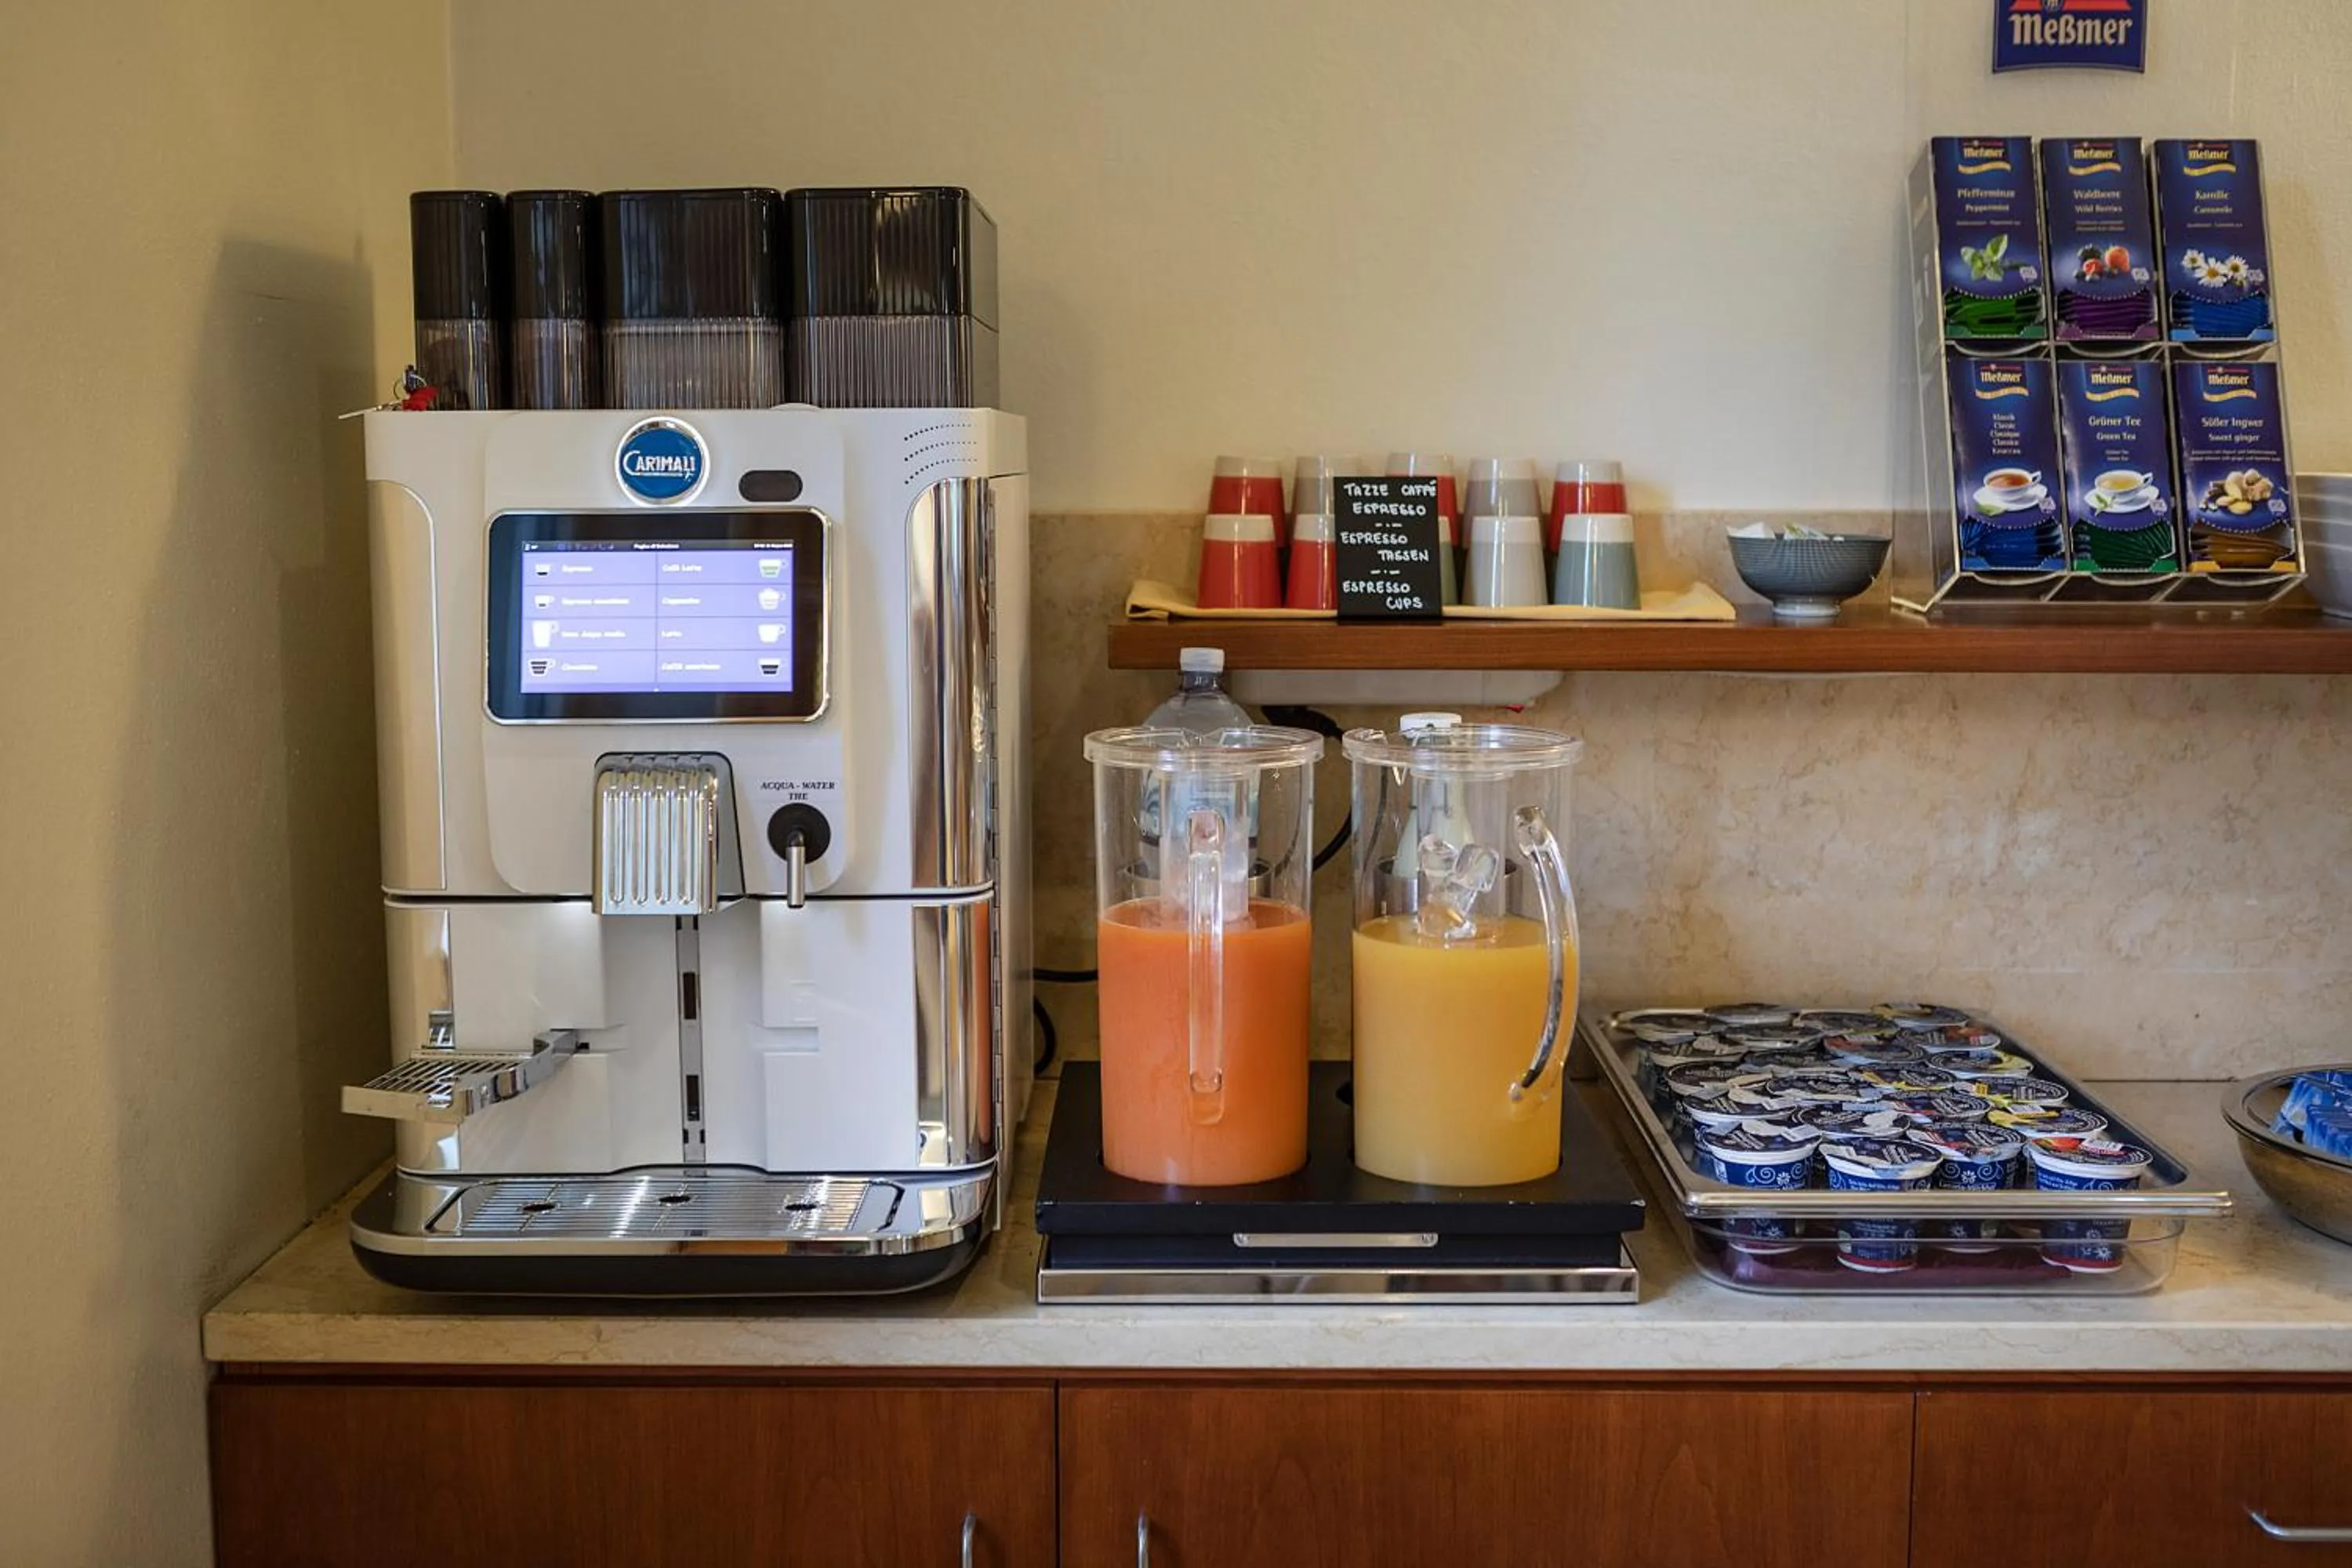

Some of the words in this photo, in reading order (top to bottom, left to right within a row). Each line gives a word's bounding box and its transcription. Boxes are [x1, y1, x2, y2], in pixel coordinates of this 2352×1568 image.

[2008, 13, 2133, 45] Meßmer
[2088, 416, 2122, 426] Grüner
[623, 450, 696, 477] CARIMALI
[1343, 483, 1389, 496] TAZZE
[1352, 502, 1426, 516] ESPRESSO
[1341, 532, 1408, 544] ESPRESSO
[1377, 550, 1429, 562] TASSEN
[1342, 580, 1410, 593] ESPRESSO
[1385, 597, 1423, 609] CUPS
[760, 782, 794, 791] ACQUA
